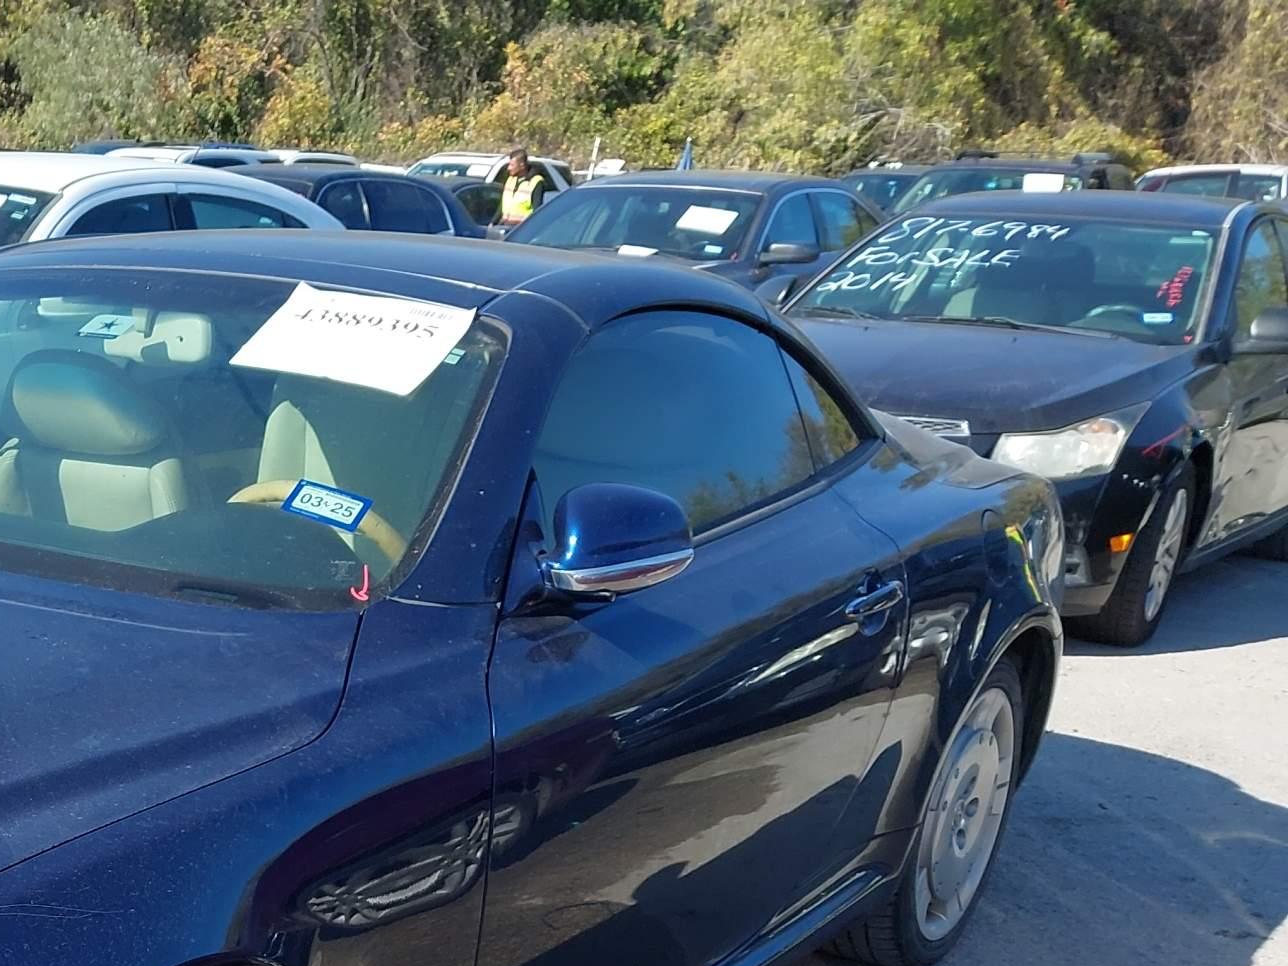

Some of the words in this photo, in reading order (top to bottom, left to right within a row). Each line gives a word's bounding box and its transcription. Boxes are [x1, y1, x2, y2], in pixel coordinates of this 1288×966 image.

[877, 216, 1071, 244] 817-6984
[913, 247, 1021, 268] SALE
[816, 271, 918, 292] 2014
